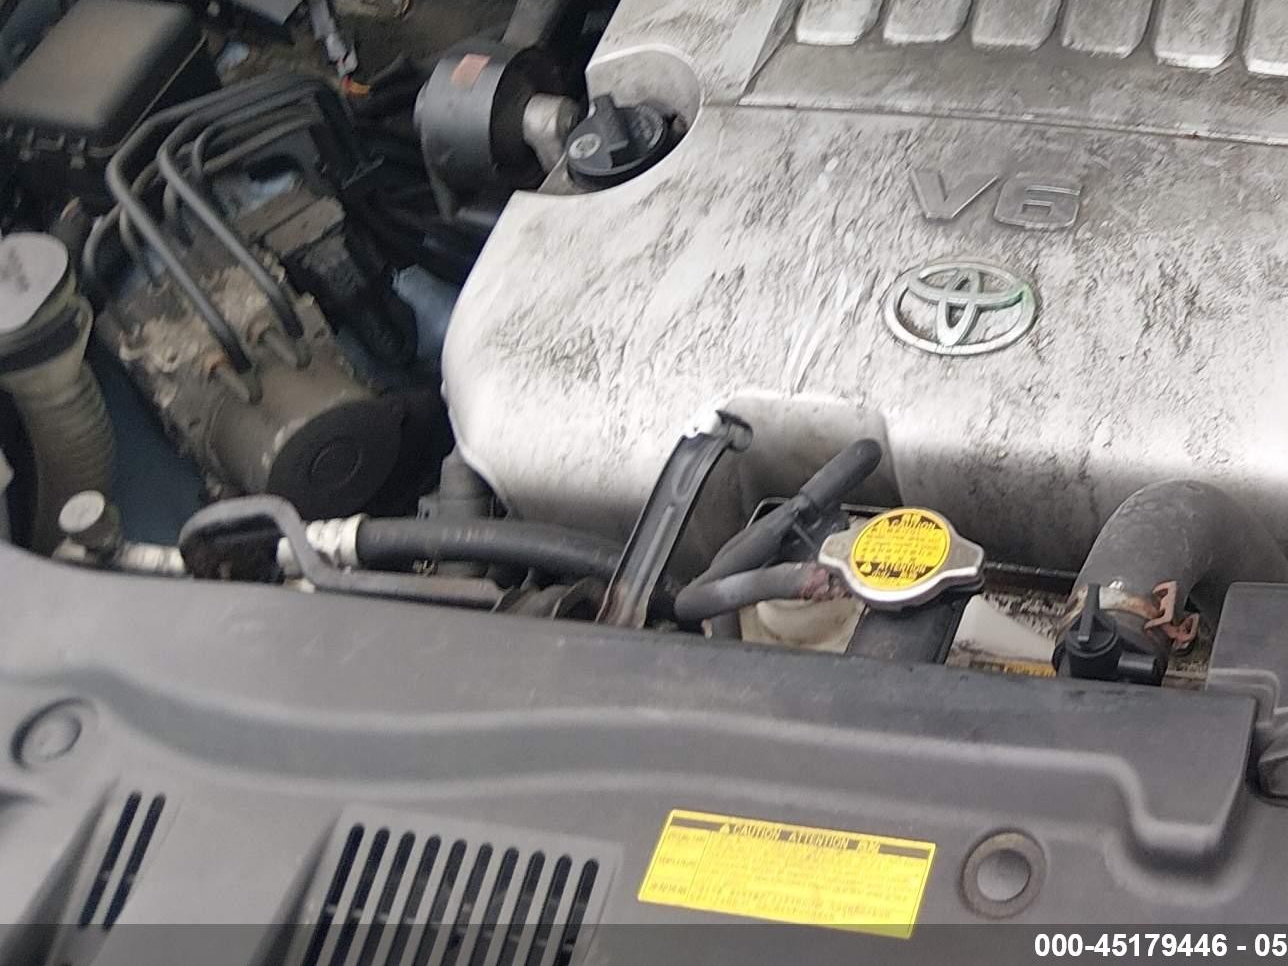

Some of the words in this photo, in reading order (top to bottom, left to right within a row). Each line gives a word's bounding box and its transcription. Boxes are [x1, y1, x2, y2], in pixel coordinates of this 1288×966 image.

[908, 167, 1084, 231] V6
[732, 823, 782, 842] CAUTION
[787, 831, 851, 851] ATTENTION
